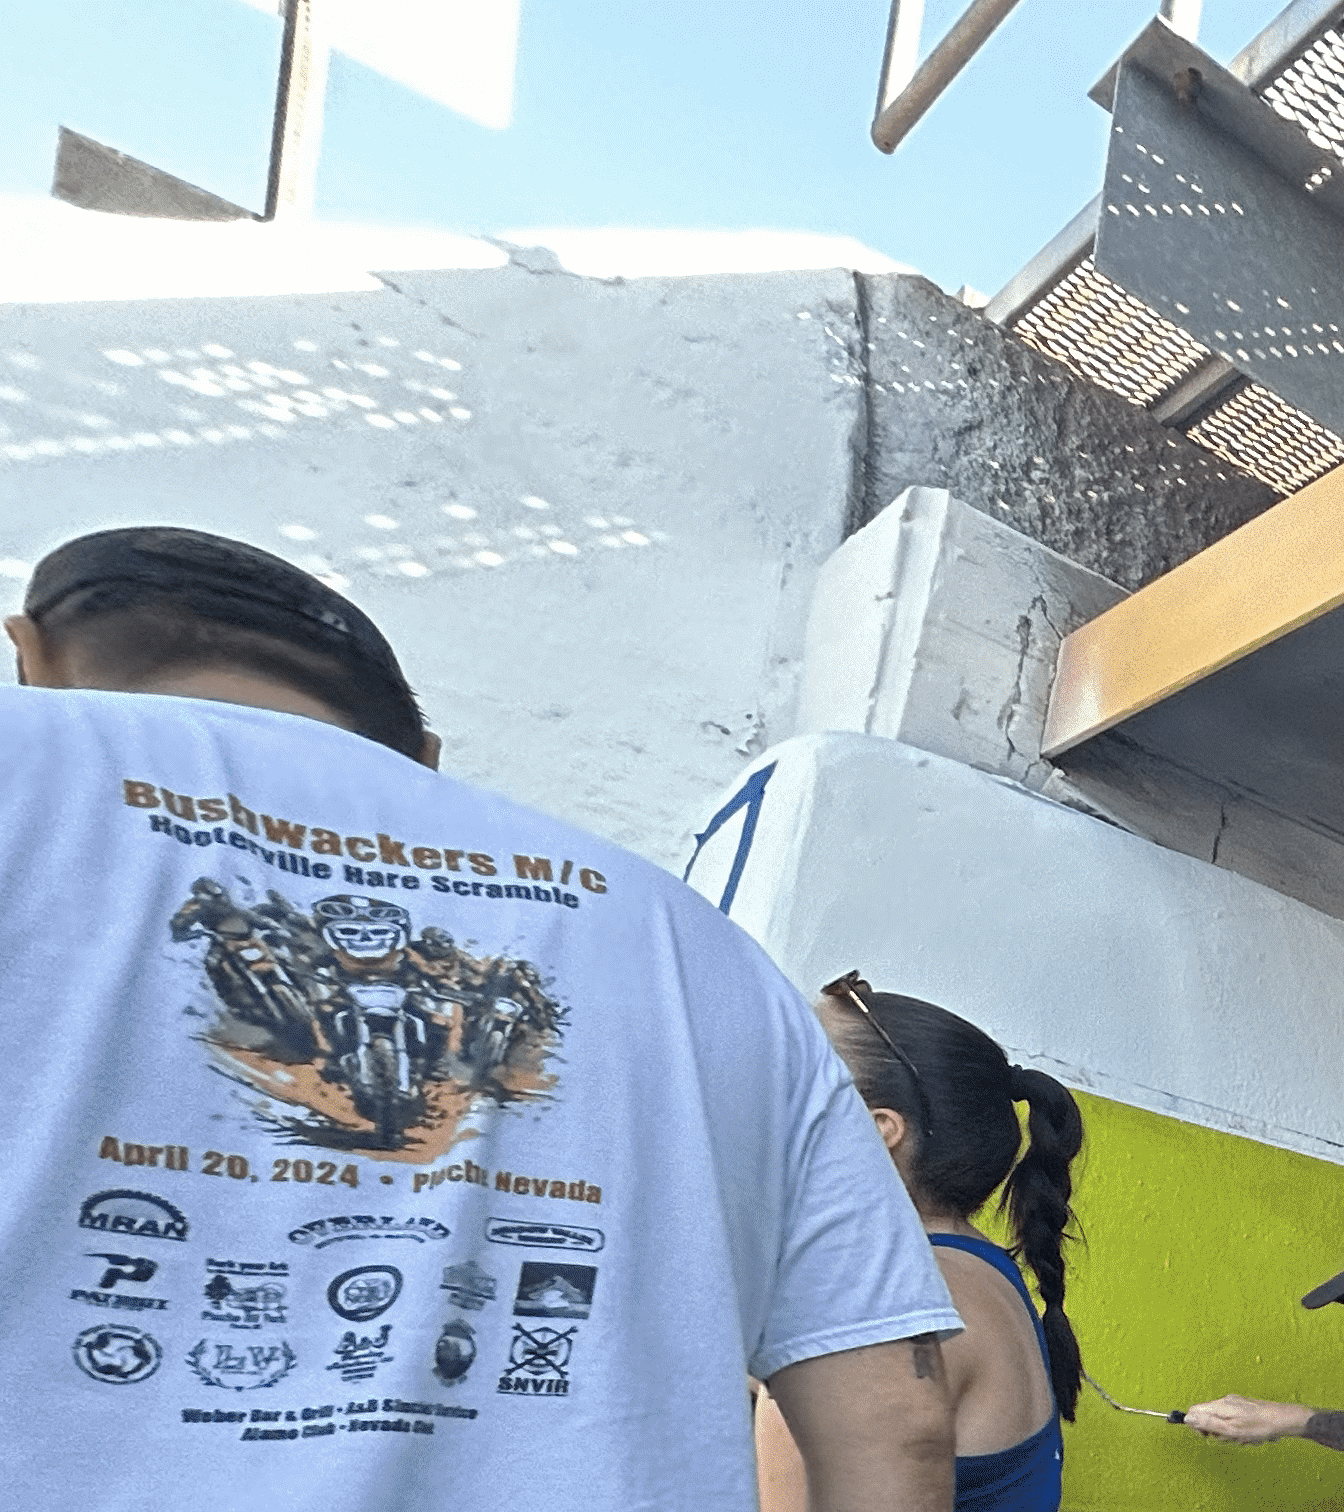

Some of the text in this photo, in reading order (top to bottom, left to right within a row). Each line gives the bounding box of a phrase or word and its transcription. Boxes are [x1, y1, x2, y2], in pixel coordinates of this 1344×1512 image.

[122, 779, 609, 895] Bushwackers M/C
[149, 814, 581, 909] Hooterville Hare Scramble
[99, 1136, 190, 1172] April
[201, 1150, 259, 1183] 20,
[270, 1158, 360, 1189] 2024
[494, 1172, 603, 1205] Nevada
[80, 1208, 190, 1242] MRAN
